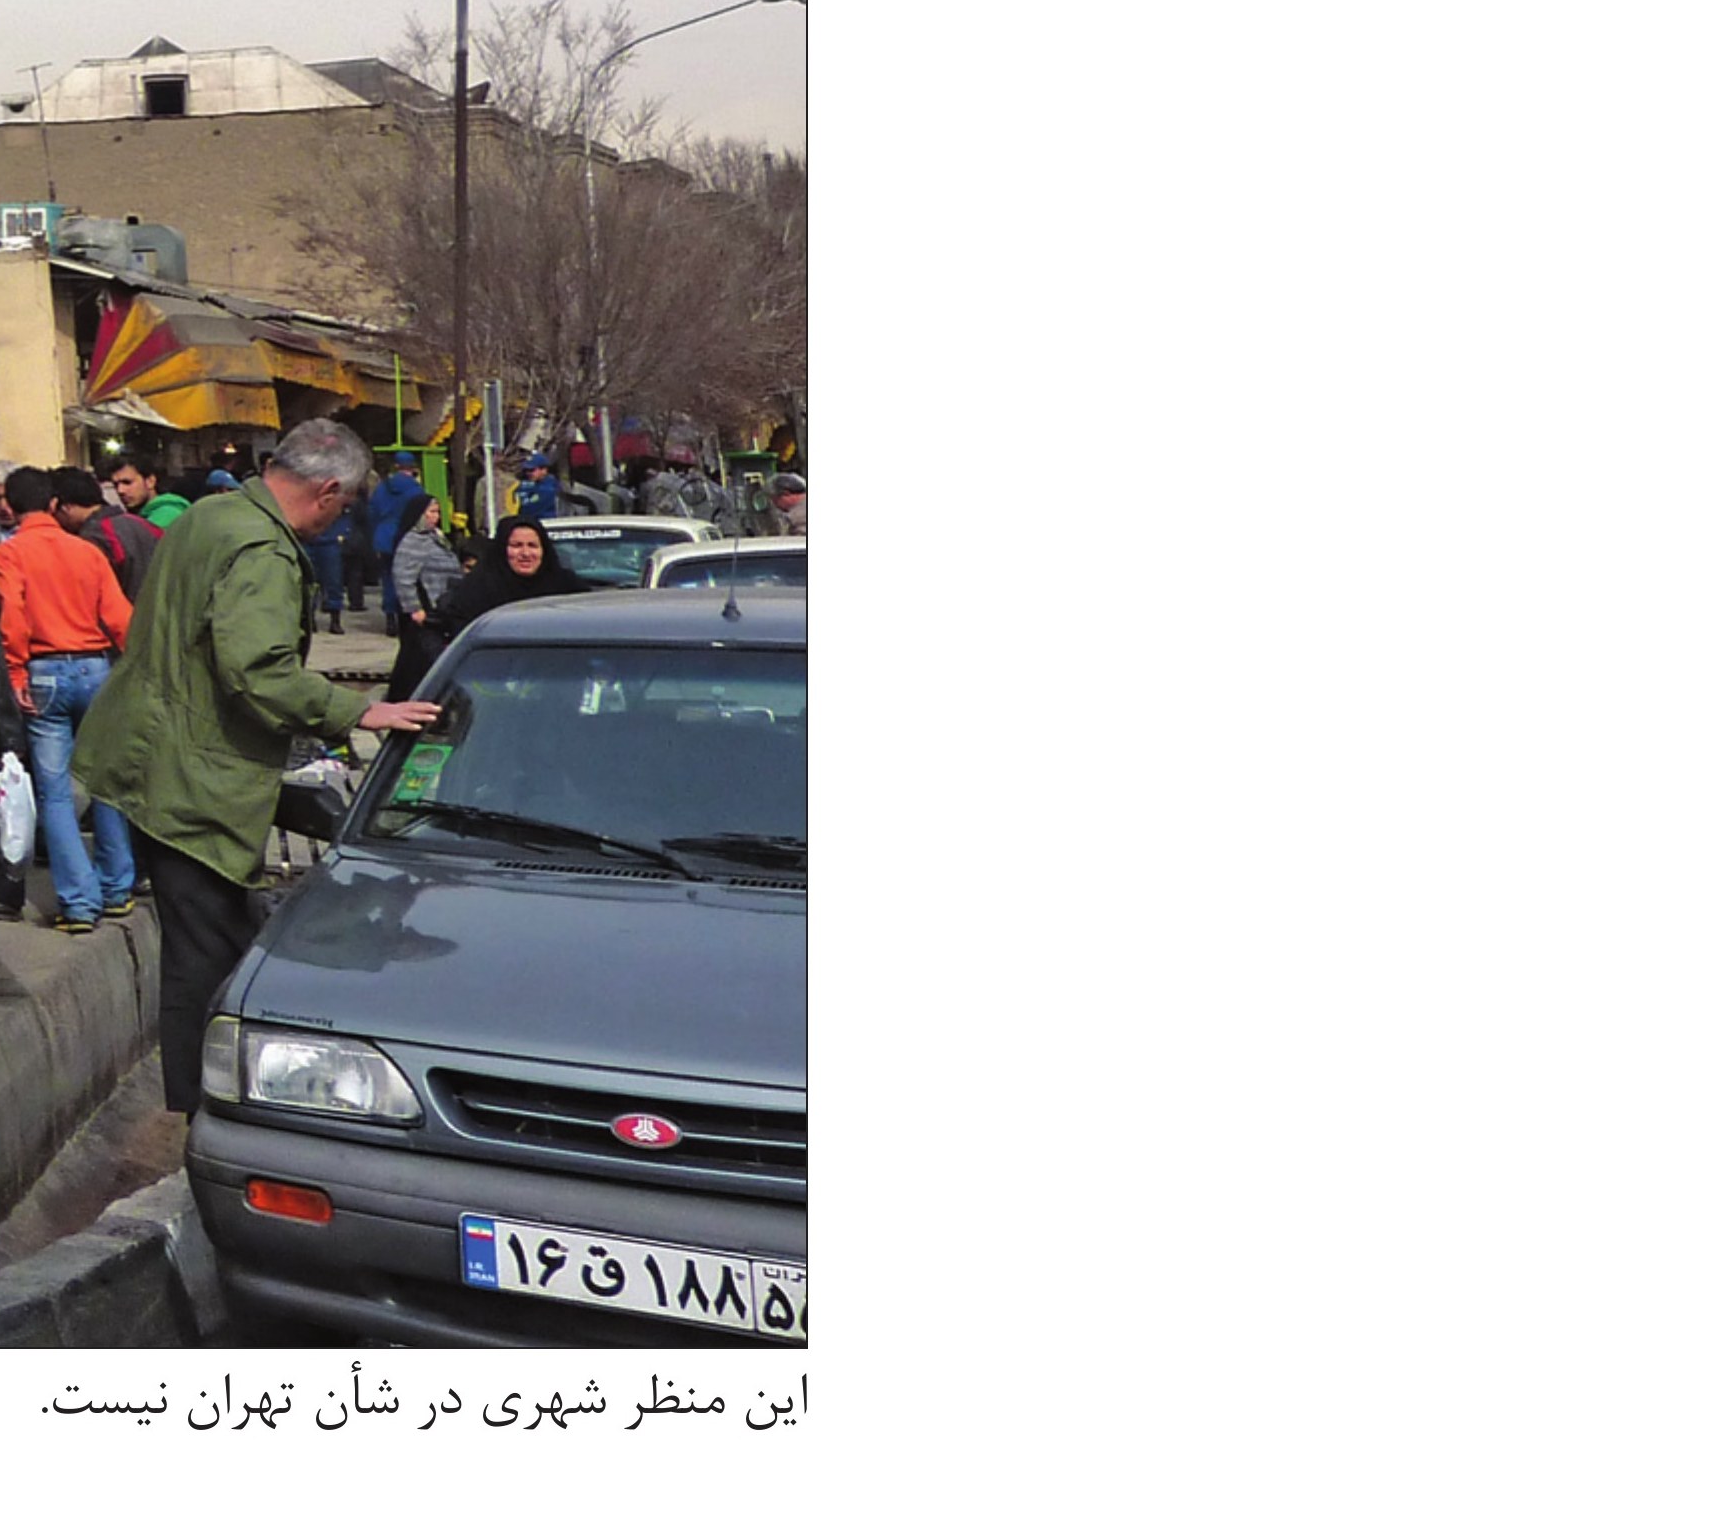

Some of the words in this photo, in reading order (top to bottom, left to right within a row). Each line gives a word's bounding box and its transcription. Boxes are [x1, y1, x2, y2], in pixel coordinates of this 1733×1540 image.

[507, 1233, 567, 1287] ۱۶
[581, 1245, 626, 1298] ق
[644, 1253, 747, 1320] ۱۸۸
